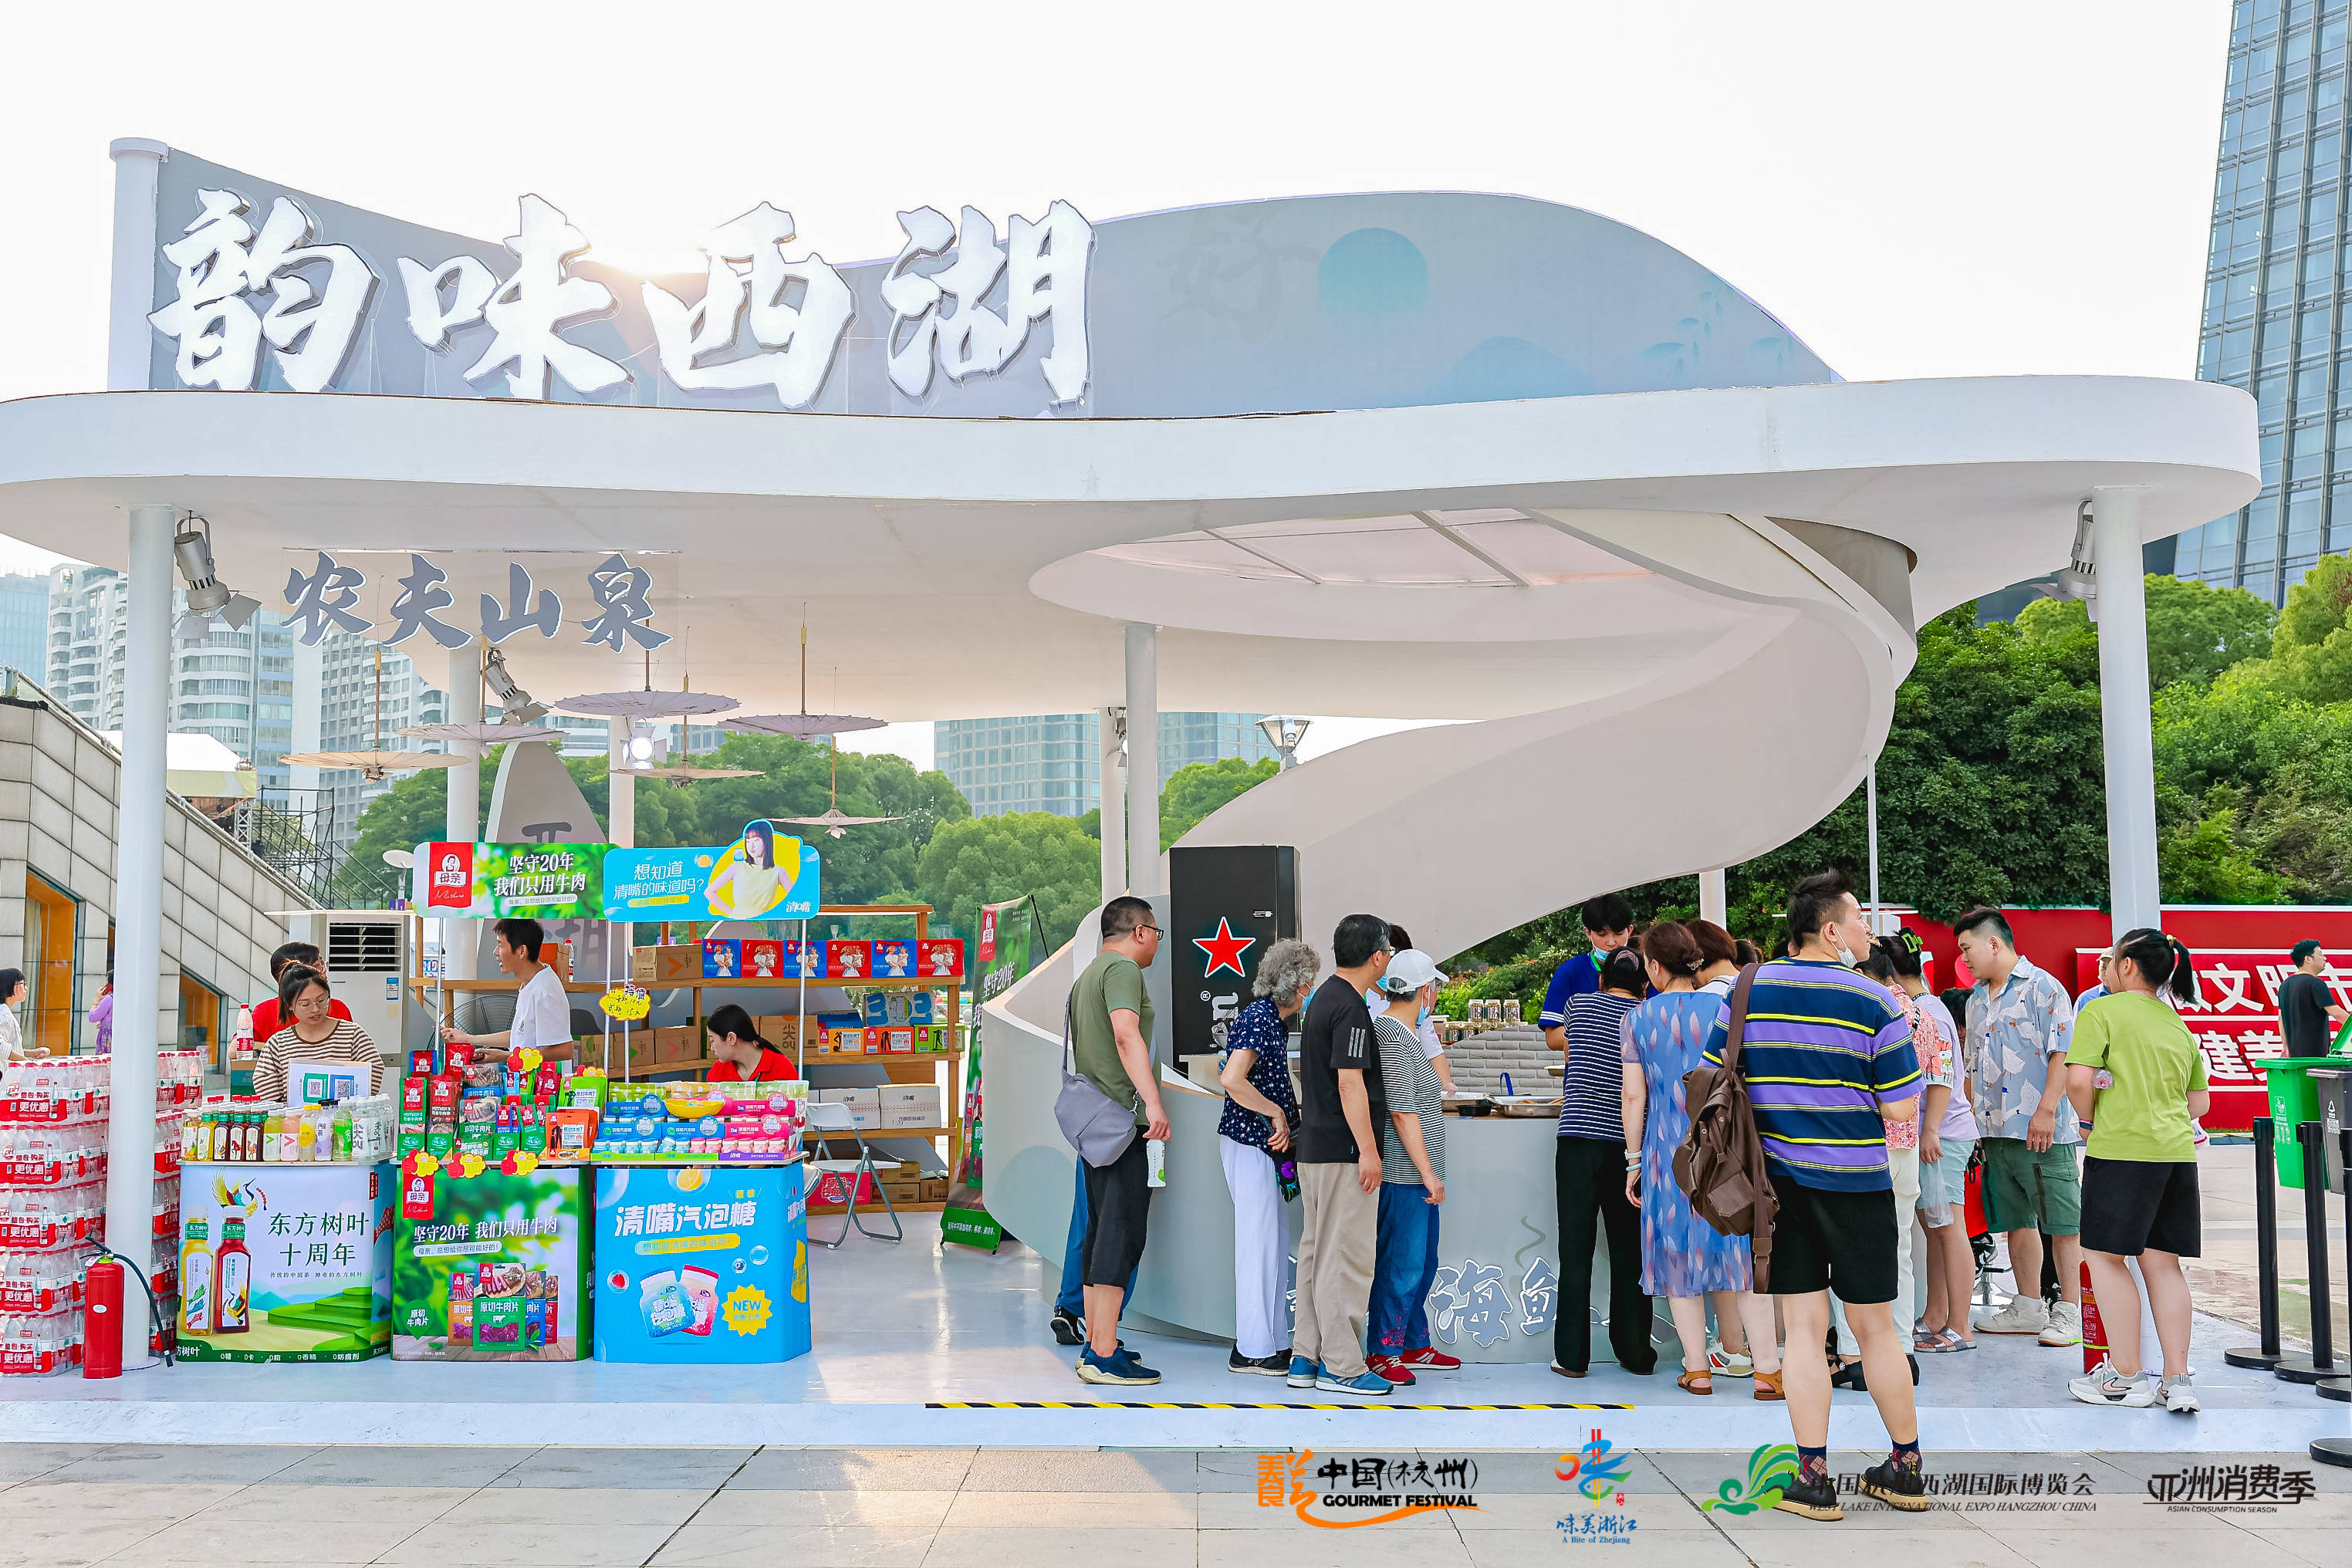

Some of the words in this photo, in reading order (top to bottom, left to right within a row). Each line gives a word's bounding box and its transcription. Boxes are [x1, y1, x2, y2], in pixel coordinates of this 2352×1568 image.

[147, 188, 1097, 410] 韵味西湖
[282, 551, 674, 654] 农夫山泉
[509, 852, 574, 874] 坚守20年
[634, 860, 684, 880] 想知道
[440, 873, 461, 884] 母亲
[494, 872, 586, 897] 我们只用牛肉
[982, 961, 1015, 999] 坚守20年
[782, 1024, 796, 1050] 尖叫
[19, 1101, 49, 1112] 更优惠
[15, 1164, 44, 1174] 更优惠
[410, 1192, 426, 1201] 母亲
[267, 1211, 370, 1236] 东方树叶
[614, 1201, 758, 1237] 清嘴汽泡糖
[9, 1226, 39, 1238] 更优惠
[413, 1222, 470, 1243] 坚守20年
[475, 1216, 558, 1239] 我们只用牛肉
[279, 1242, 357, 1267] 十周年
[4, 1290, 33, 1302] 更优惠
[411, 1309, 426, 1318] 原切
[480, 1302, 519, 1313] 原切牛肉片
[733, 1300, 762, 1311] NEW
[407, 1317, 429, 1326] 牛肉片
[3, 1353, 33, 1364] 更优惠
